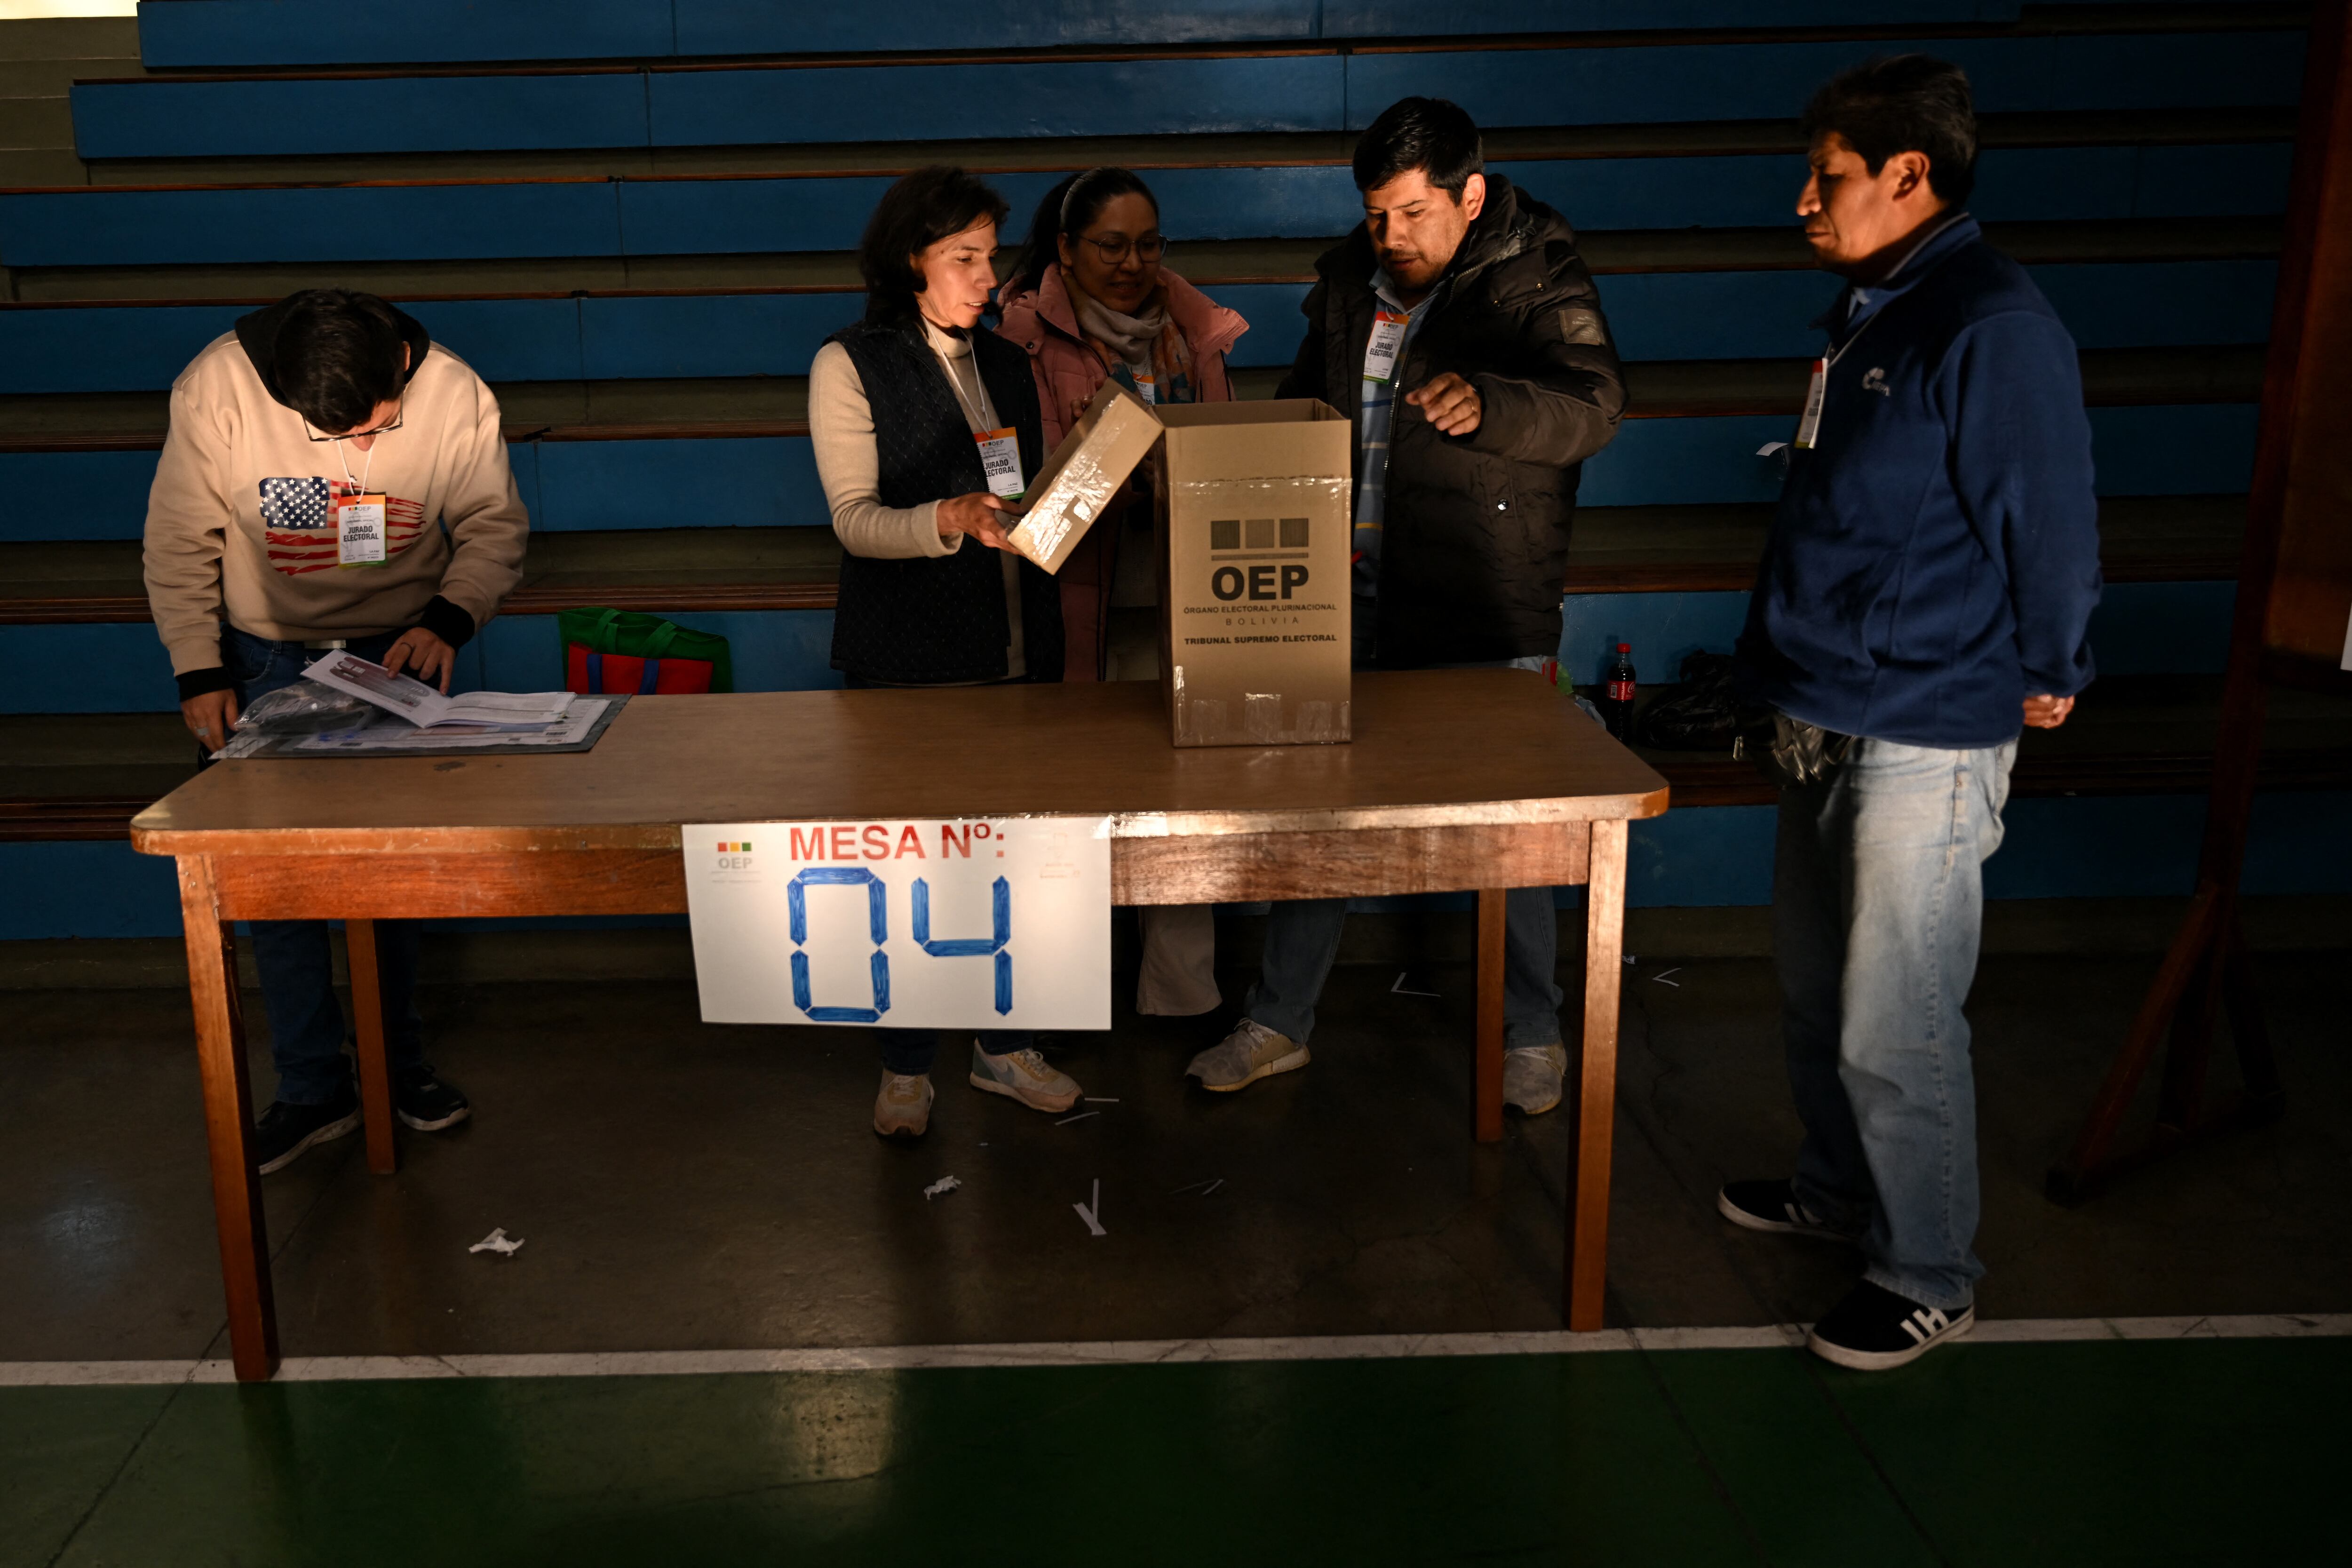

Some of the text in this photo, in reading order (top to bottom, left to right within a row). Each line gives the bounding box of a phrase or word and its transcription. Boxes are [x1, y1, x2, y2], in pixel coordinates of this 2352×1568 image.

[1375, 342, 1393, 351] JURADO
[1369, 348, 1393, 358] ELECTORAL
[985, 459, 1009, 470] JURADO
[348, 525, 373, 534] JURADO
[343, 533, 379, 542] ELECTORAL
[1211, 565, 1309, 601] OEP
[1225, 617, 1299, 626] BOLIVIA
[790, 824, 926, 860] MESA
[718, 857, 753, 869] OEP
[787, 867, 1013, 1023] 04
